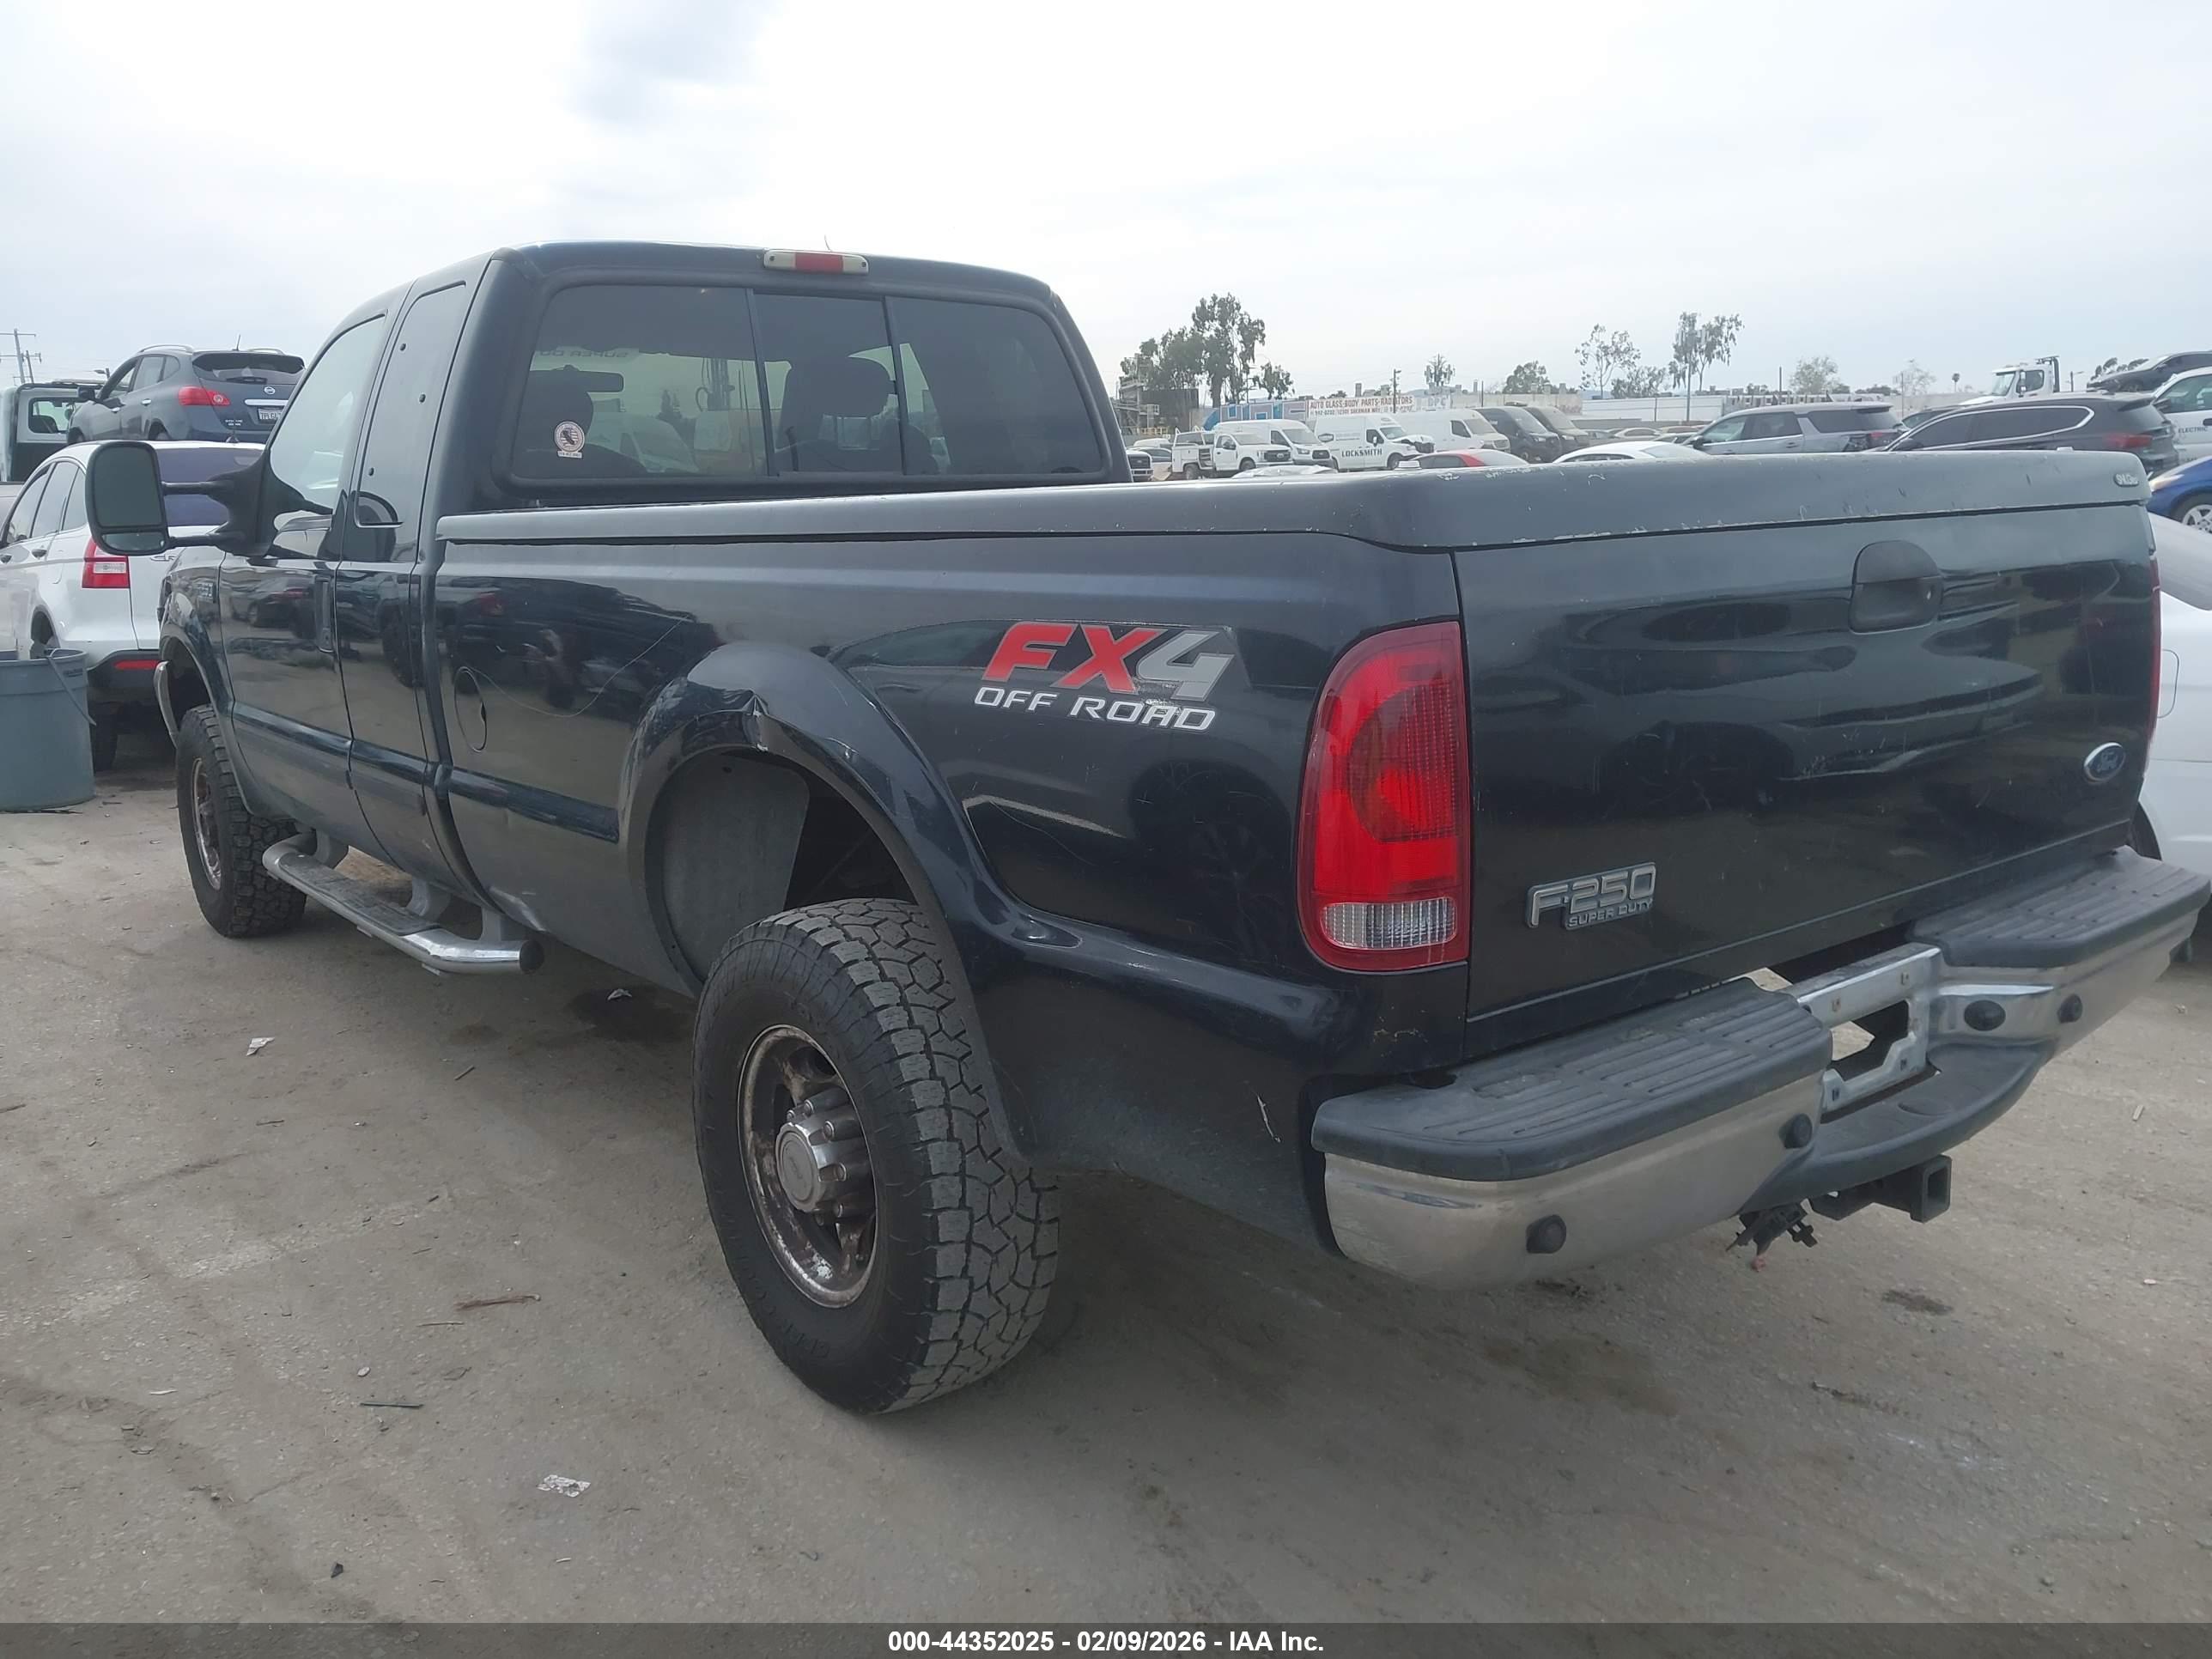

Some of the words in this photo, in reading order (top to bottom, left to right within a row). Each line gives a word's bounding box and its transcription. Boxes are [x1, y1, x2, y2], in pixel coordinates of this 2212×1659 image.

[1341, 447, 1382, 458] LOCKSMITH
[981, 621, 1234, 702] FX4
[974, 686, 1058, 712] OFF
[1067, 696, 1216, 732] ROAD
[1568, 908, 1614, 927] SUPER
[1618, 897, 1653, 915] DUTY
